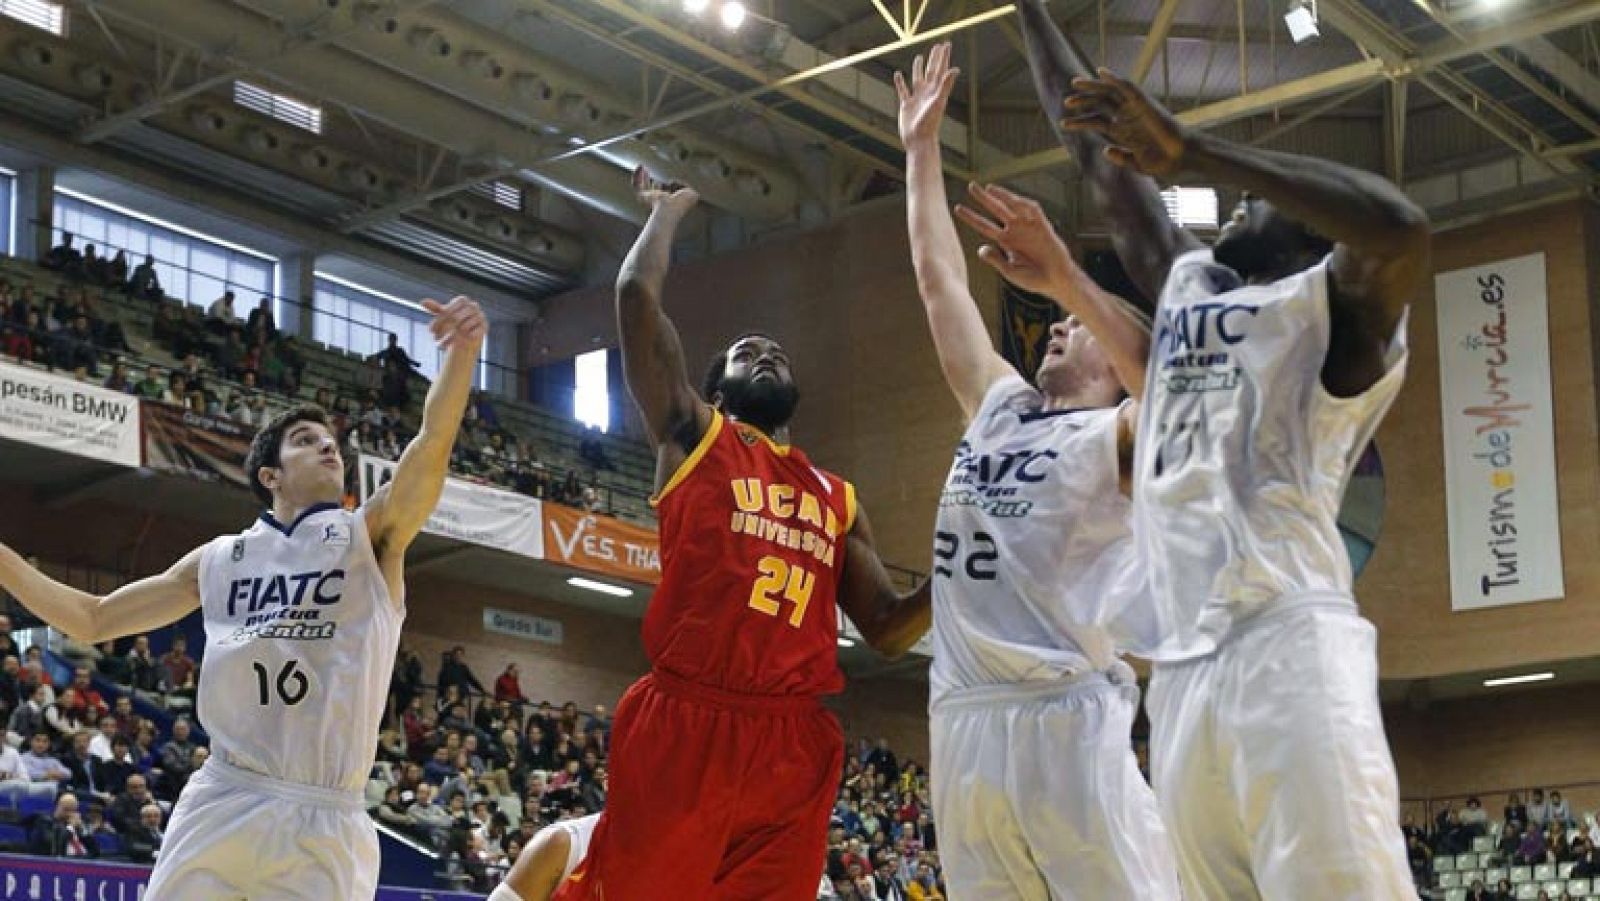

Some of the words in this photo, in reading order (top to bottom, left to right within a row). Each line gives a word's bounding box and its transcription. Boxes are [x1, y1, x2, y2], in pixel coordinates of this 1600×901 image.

[73, 394, 127, 424] BMW
[954, 441, 1057, 482] ATC
[934, 531, 998, 581] 22
[227, 568, 345, 616] FIATC
[748, 555, 815, 629] 24
[254, 660, 309, 705] 16
